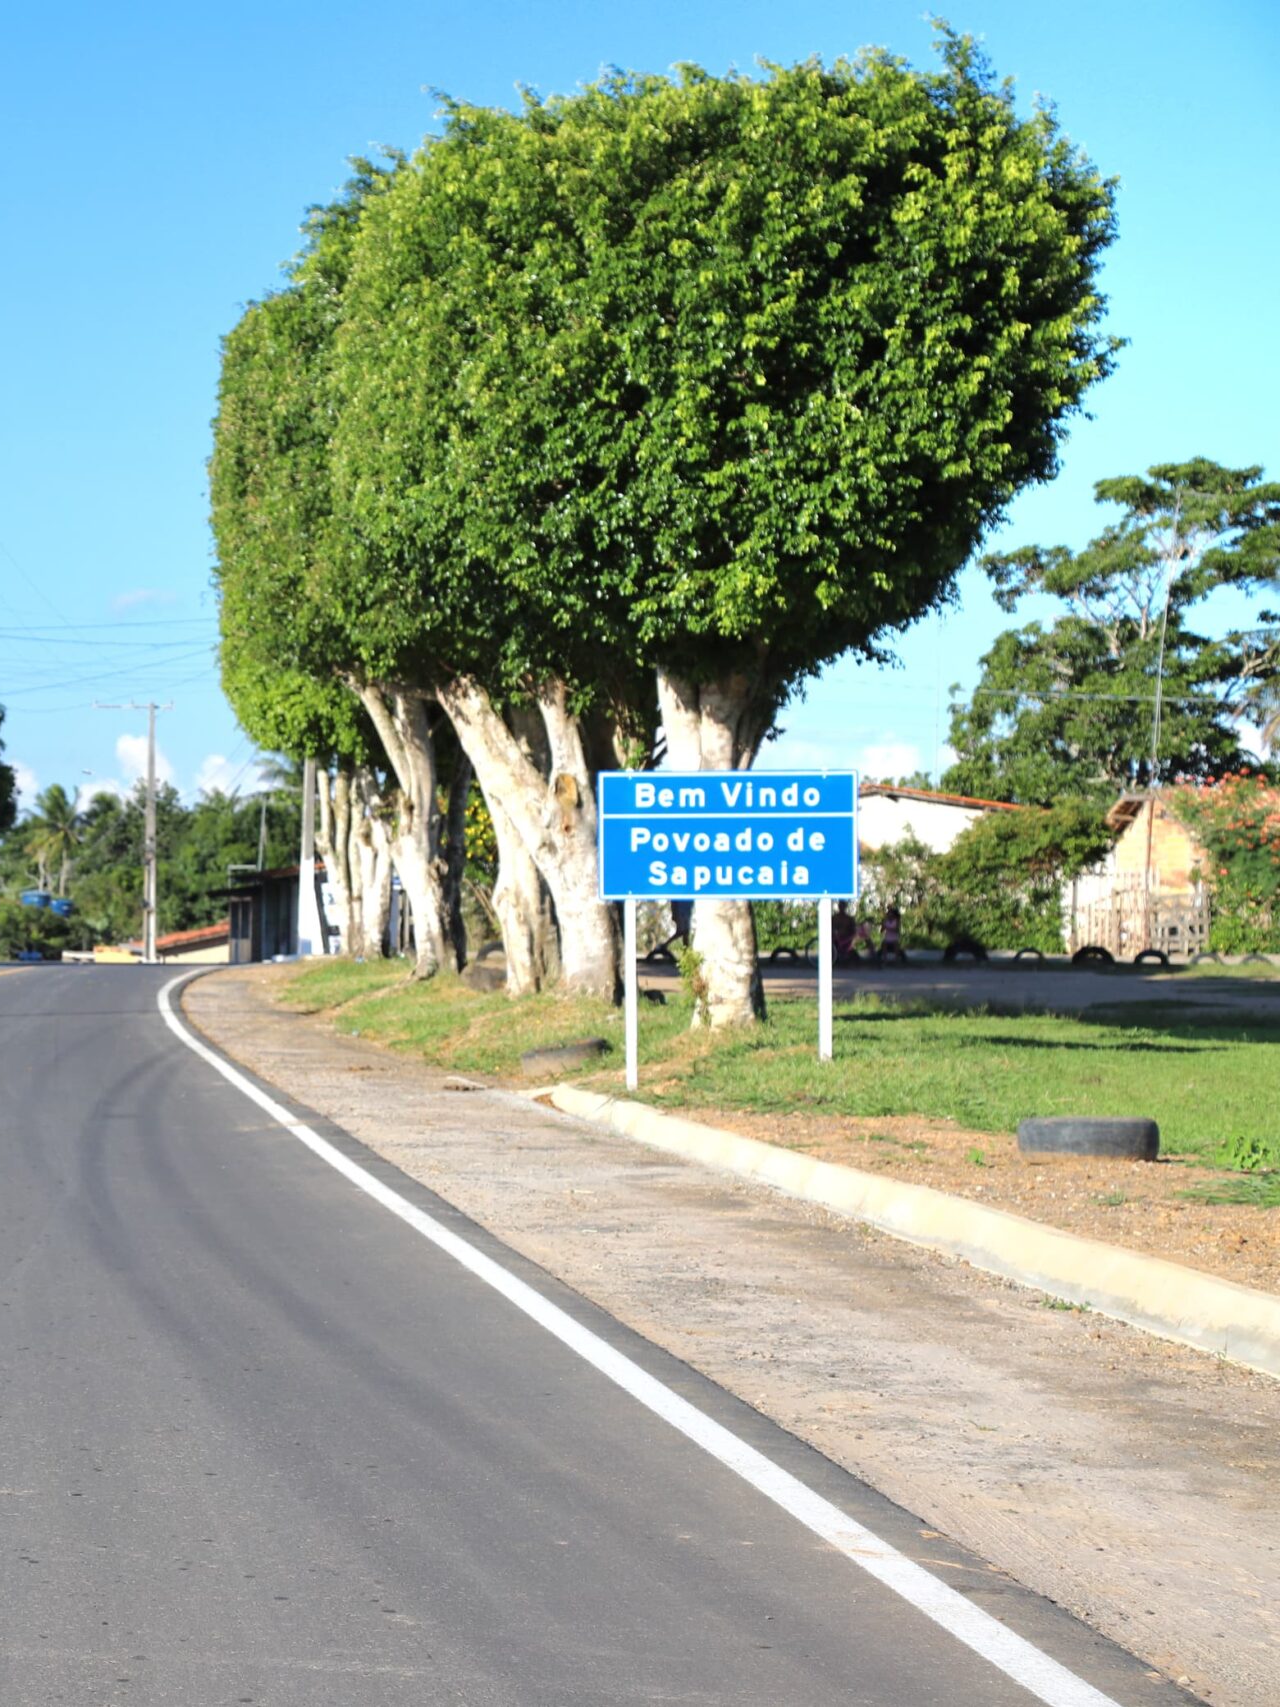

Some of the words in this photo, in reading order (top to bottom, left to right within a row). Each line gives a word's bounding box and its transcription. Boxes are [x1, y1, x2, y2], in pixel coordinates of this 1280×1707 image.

[635, 783, 705, 808] Bem
[721, 782, 820, 807] Vindo
[631, 827, 774, 852] Povoado
[787, 827, 825, 851] de
[648, 860, 809, 891] Sapucaia
